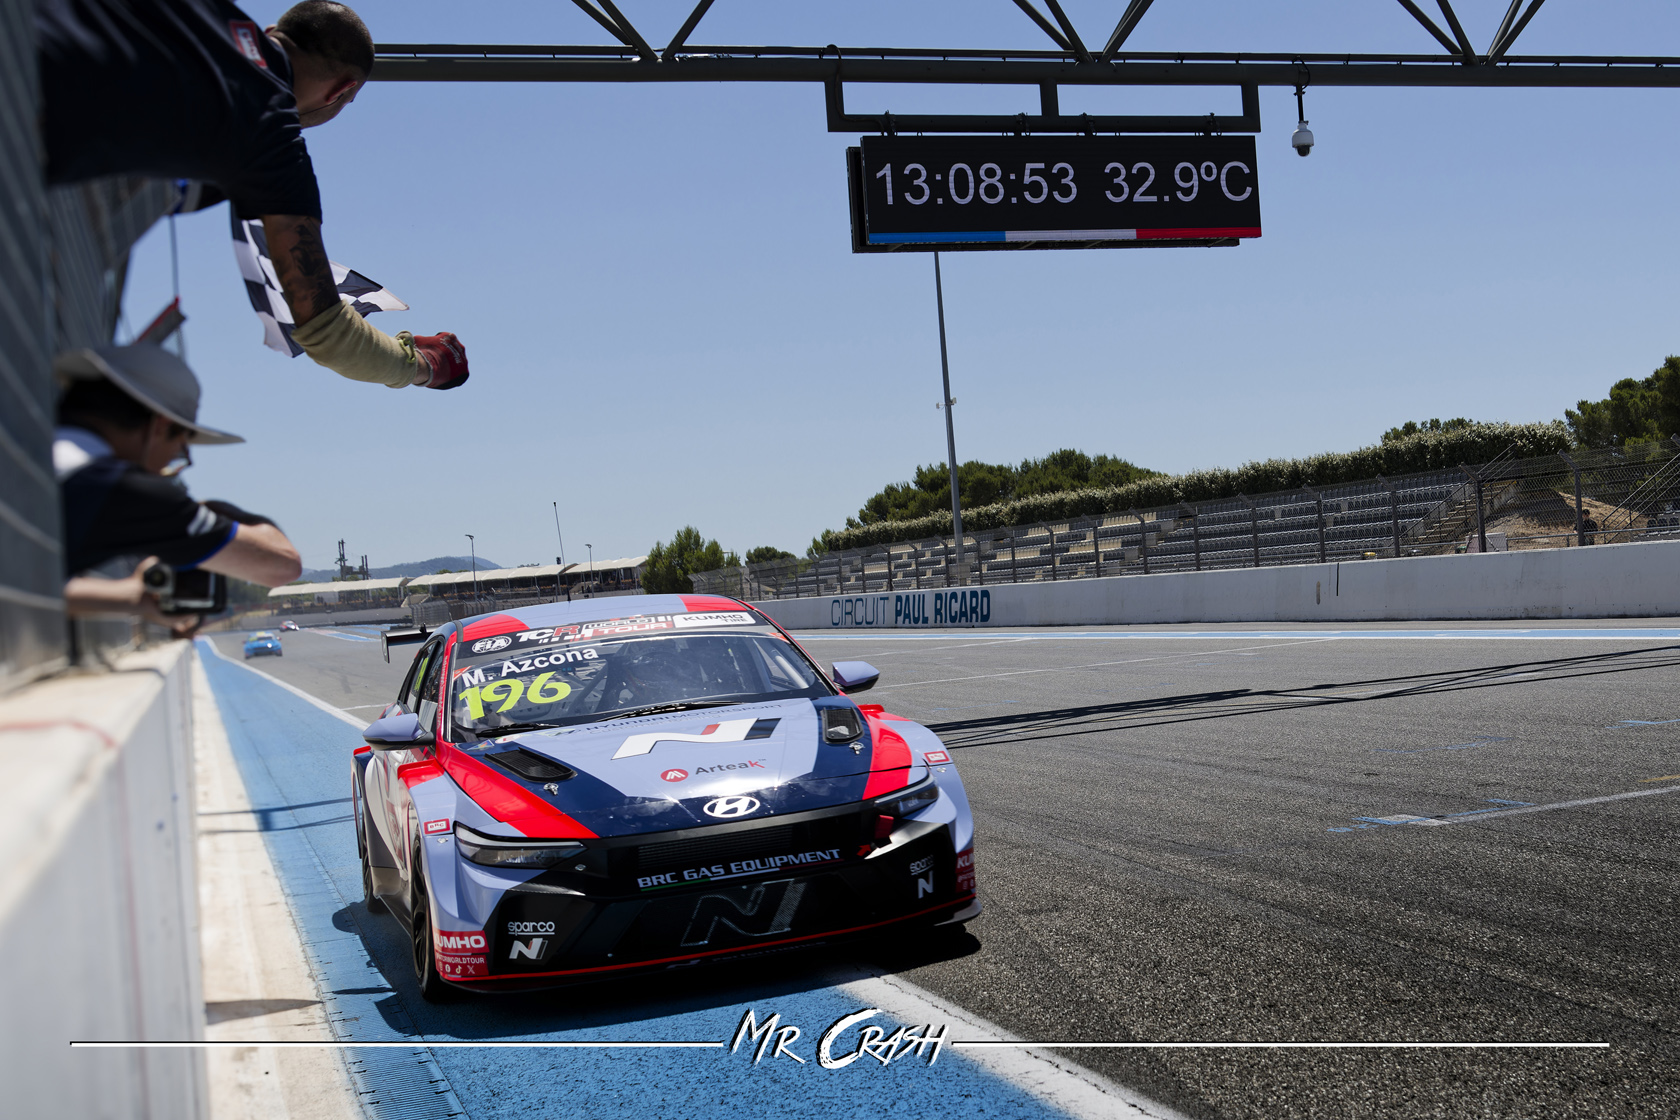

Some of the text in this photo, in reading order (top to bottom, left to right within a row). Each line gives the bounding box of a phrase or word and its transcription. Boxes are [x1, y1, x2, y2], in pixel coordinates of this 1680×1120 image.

[876, 162, 1078, 205] 13:08:53
[682, 613, 743, 622] KUMHO
[831, 590, 991, 626] CIRCUIT PAUL RICARD
[516, 625, 580, 642] TCR
[600, 622, 668, 634] TOUR
[474, 639, 509, 653] FIA
[462, 648, 599, 687] M. Azcona
[459, 671, 571, 720] 196
[586, 704, 783, 731] HYUNDAI MOTORSPORT
[637, 849, 840, 888] BRC GAS EQUIPMENT
[917, 870, 934, 899] N
[508, 921, 556, 936] sparco
